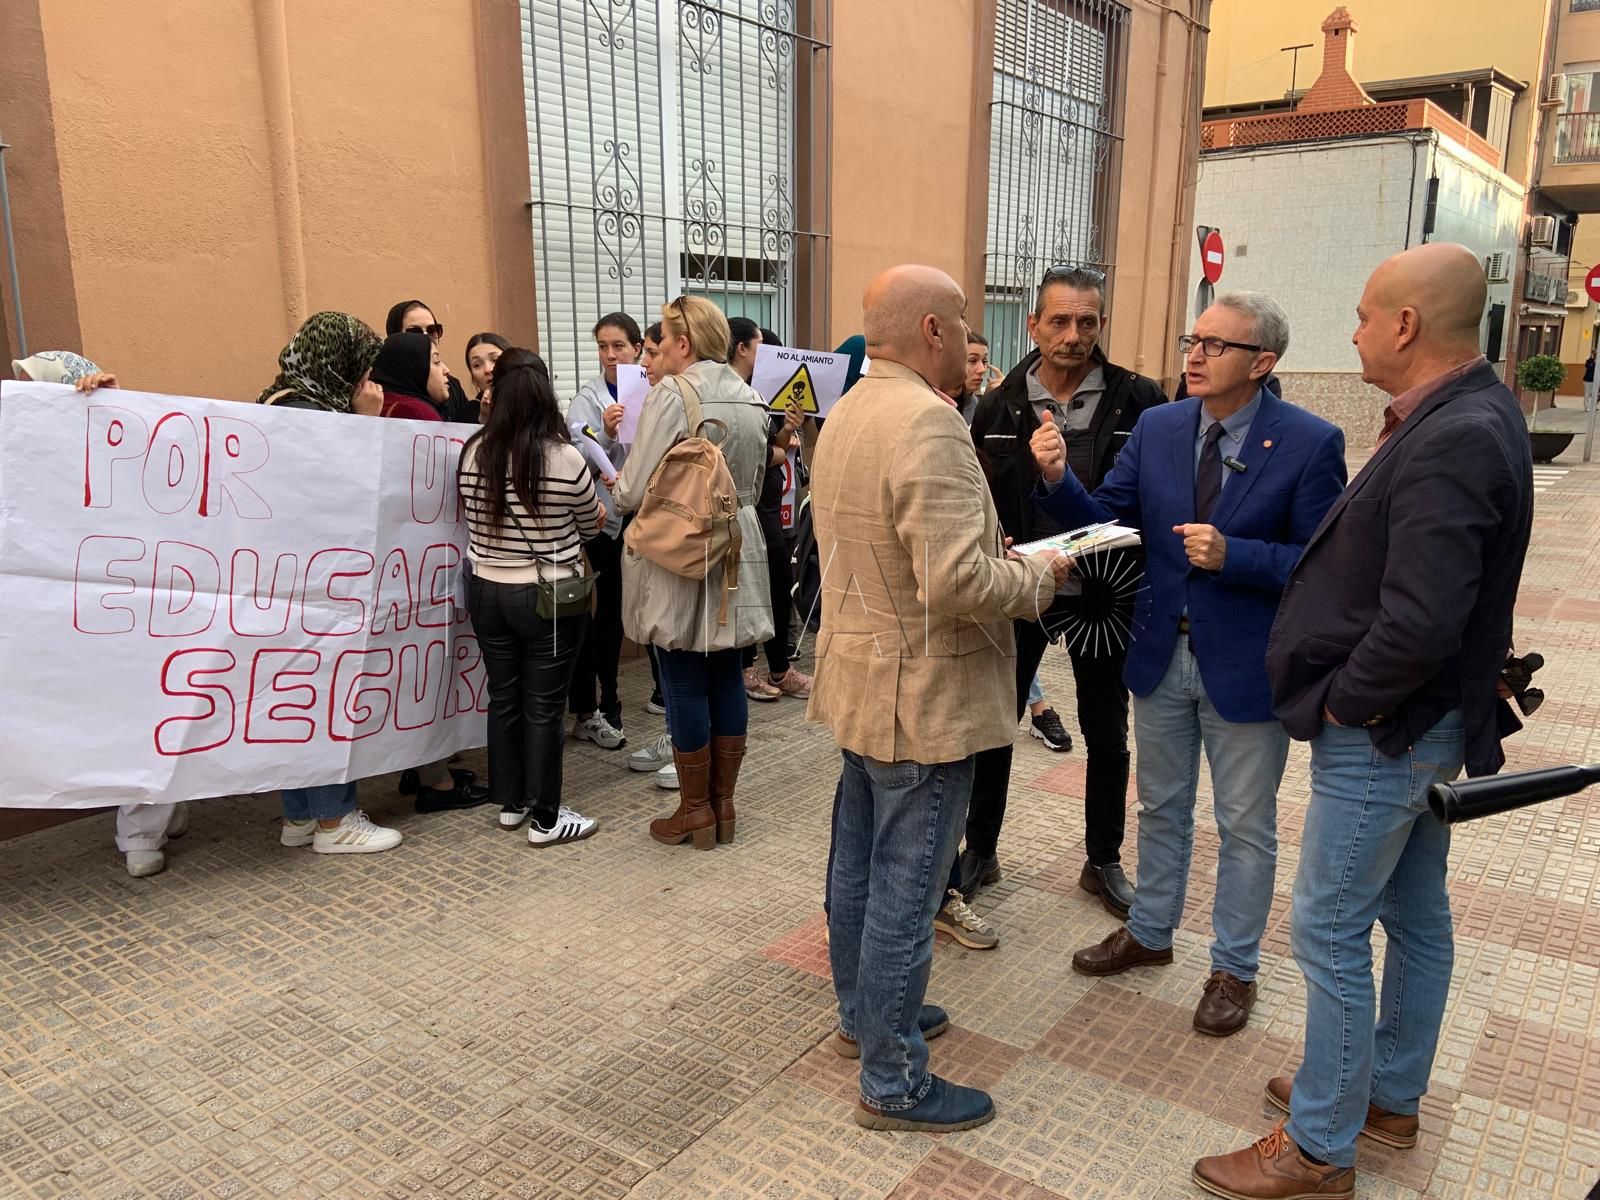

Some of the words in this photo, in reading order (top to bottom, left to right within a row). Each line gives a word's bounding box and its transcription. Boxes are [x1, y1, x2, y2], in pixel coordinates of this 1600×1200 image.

[640, 370, 647, 379] N
[776, 351, 790, 360] NO
[790, 354, 800, 362] AL
[800, 356, 834, 365] AMIANTO
[83, 404, 273, 520] POR
[73, 534, 470, 638] EDUCAC
